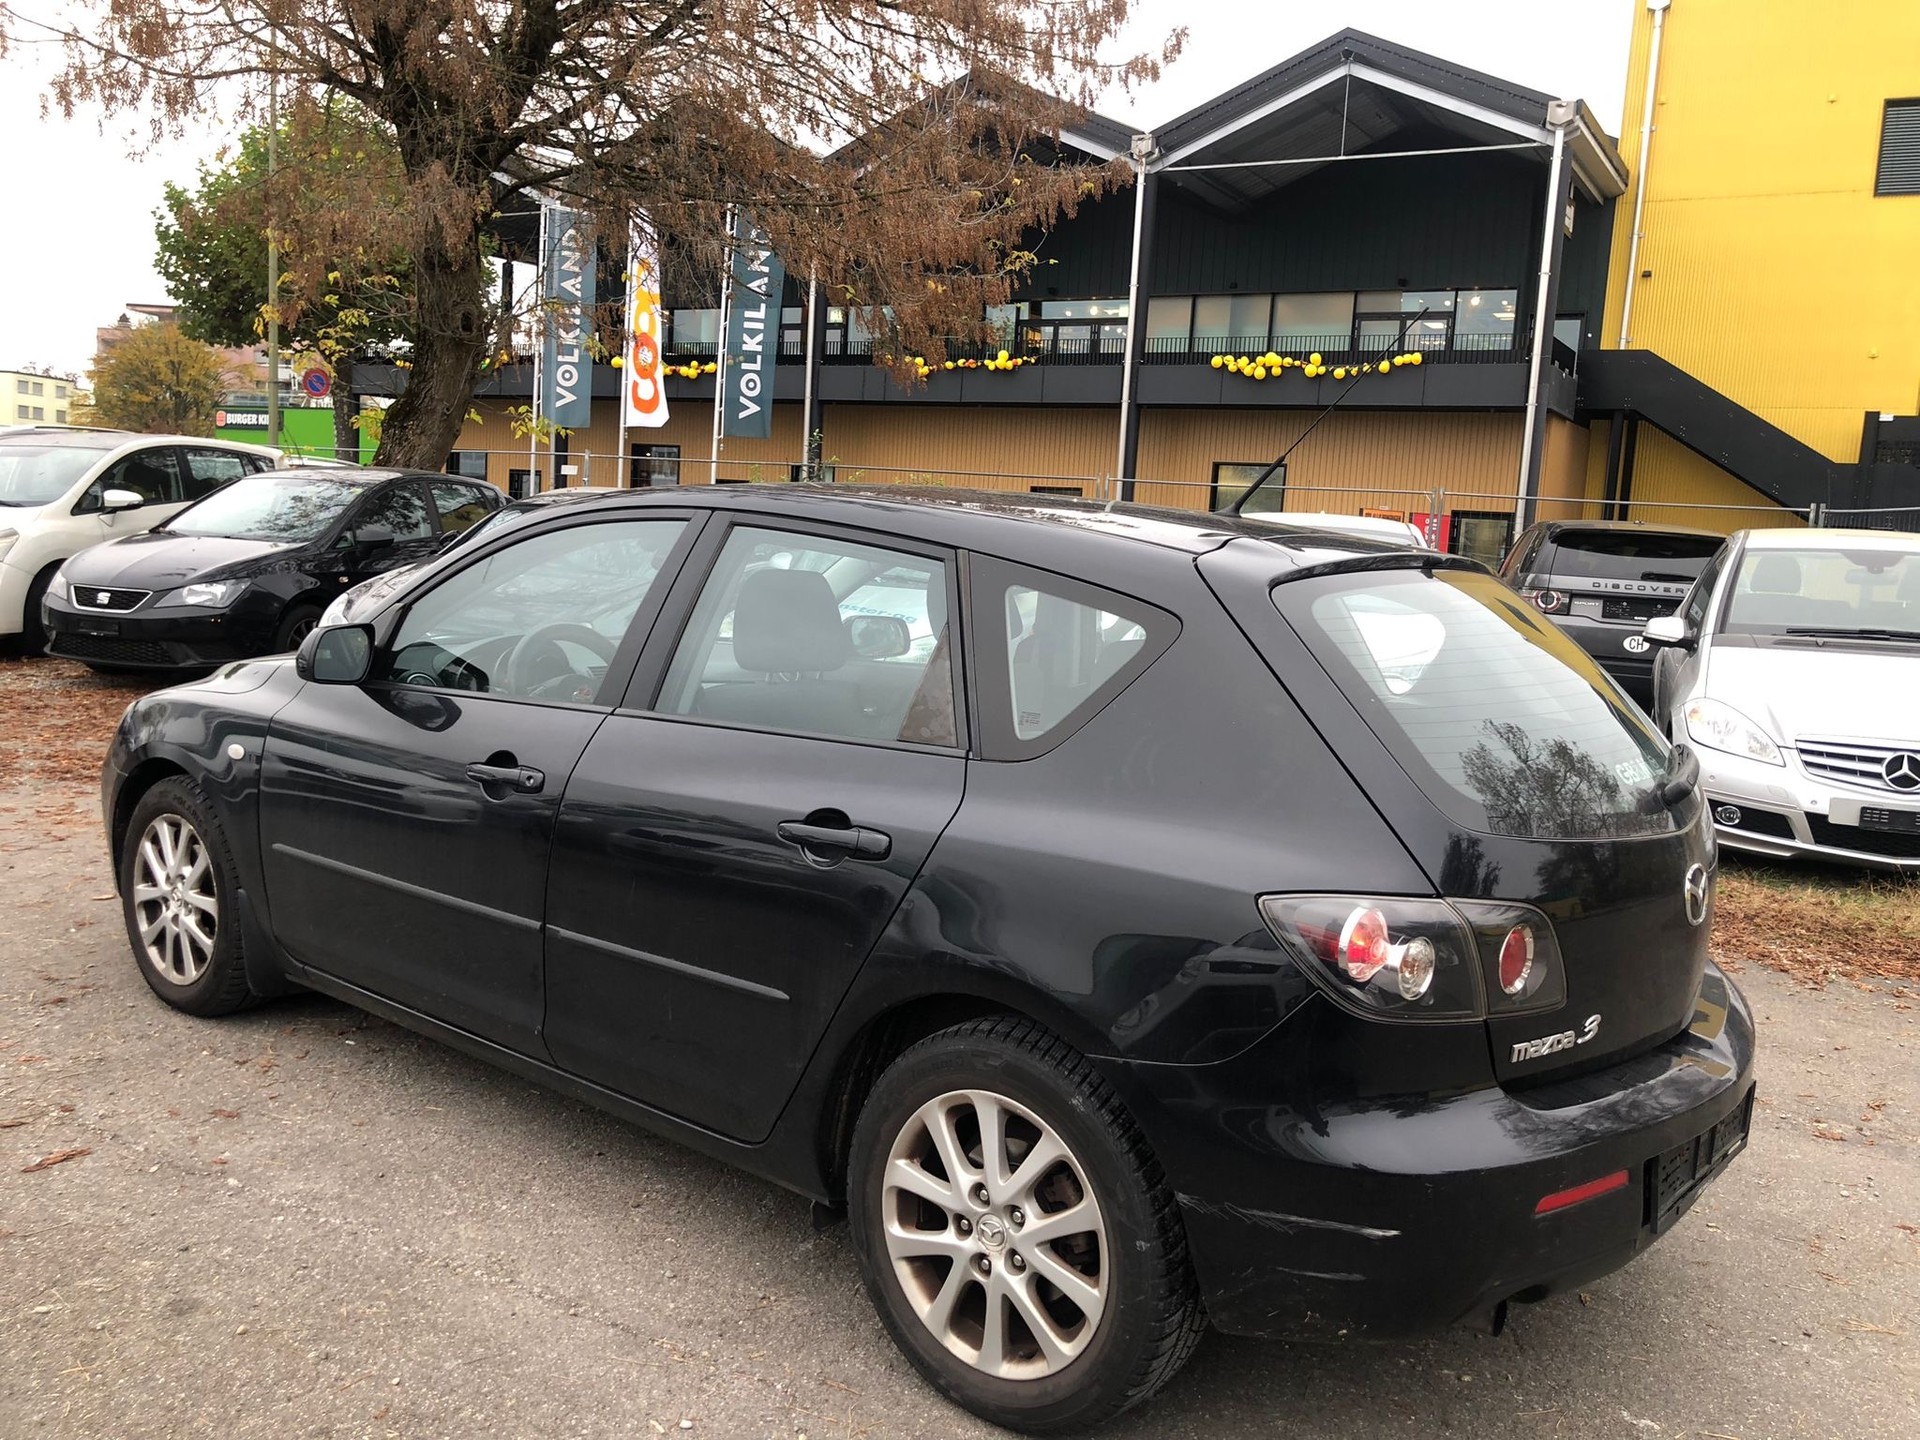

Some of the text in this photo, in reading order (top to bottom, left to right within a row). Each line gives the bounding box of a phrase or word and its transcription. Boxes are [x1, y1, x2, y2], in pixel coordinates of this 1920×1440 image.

[226, 413, 258, 425] BURGER
[1592, 581, 1693, 594] DISCOVER
[1628, 638, 1644, 651] CH
[1510, 1013, 1602, 1063] mazda 3
